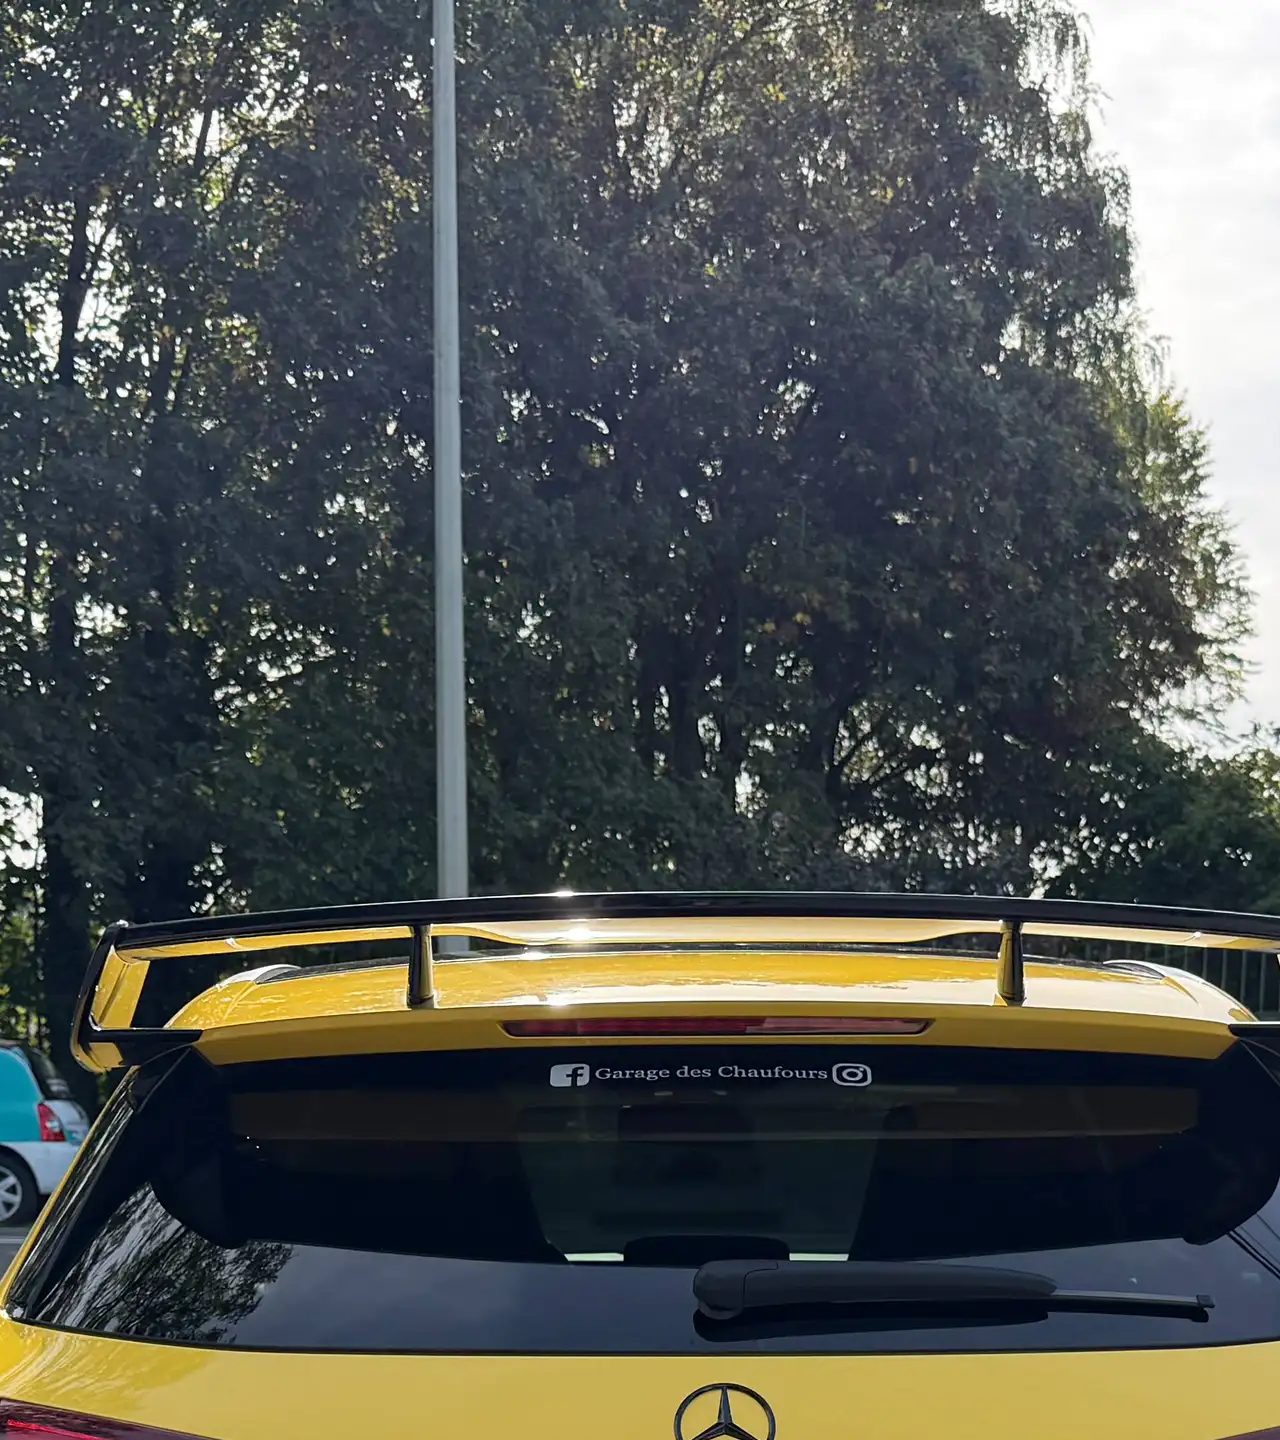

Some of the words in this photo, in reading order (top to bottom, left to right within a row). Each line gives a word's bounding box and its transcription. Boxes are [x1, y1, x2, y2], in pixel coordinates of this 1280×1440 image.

[595, 1066, 671, 1081] Garage
[676, 1065, 712, 1079] des
[717, 1064, 829, 1080] Chaufours
